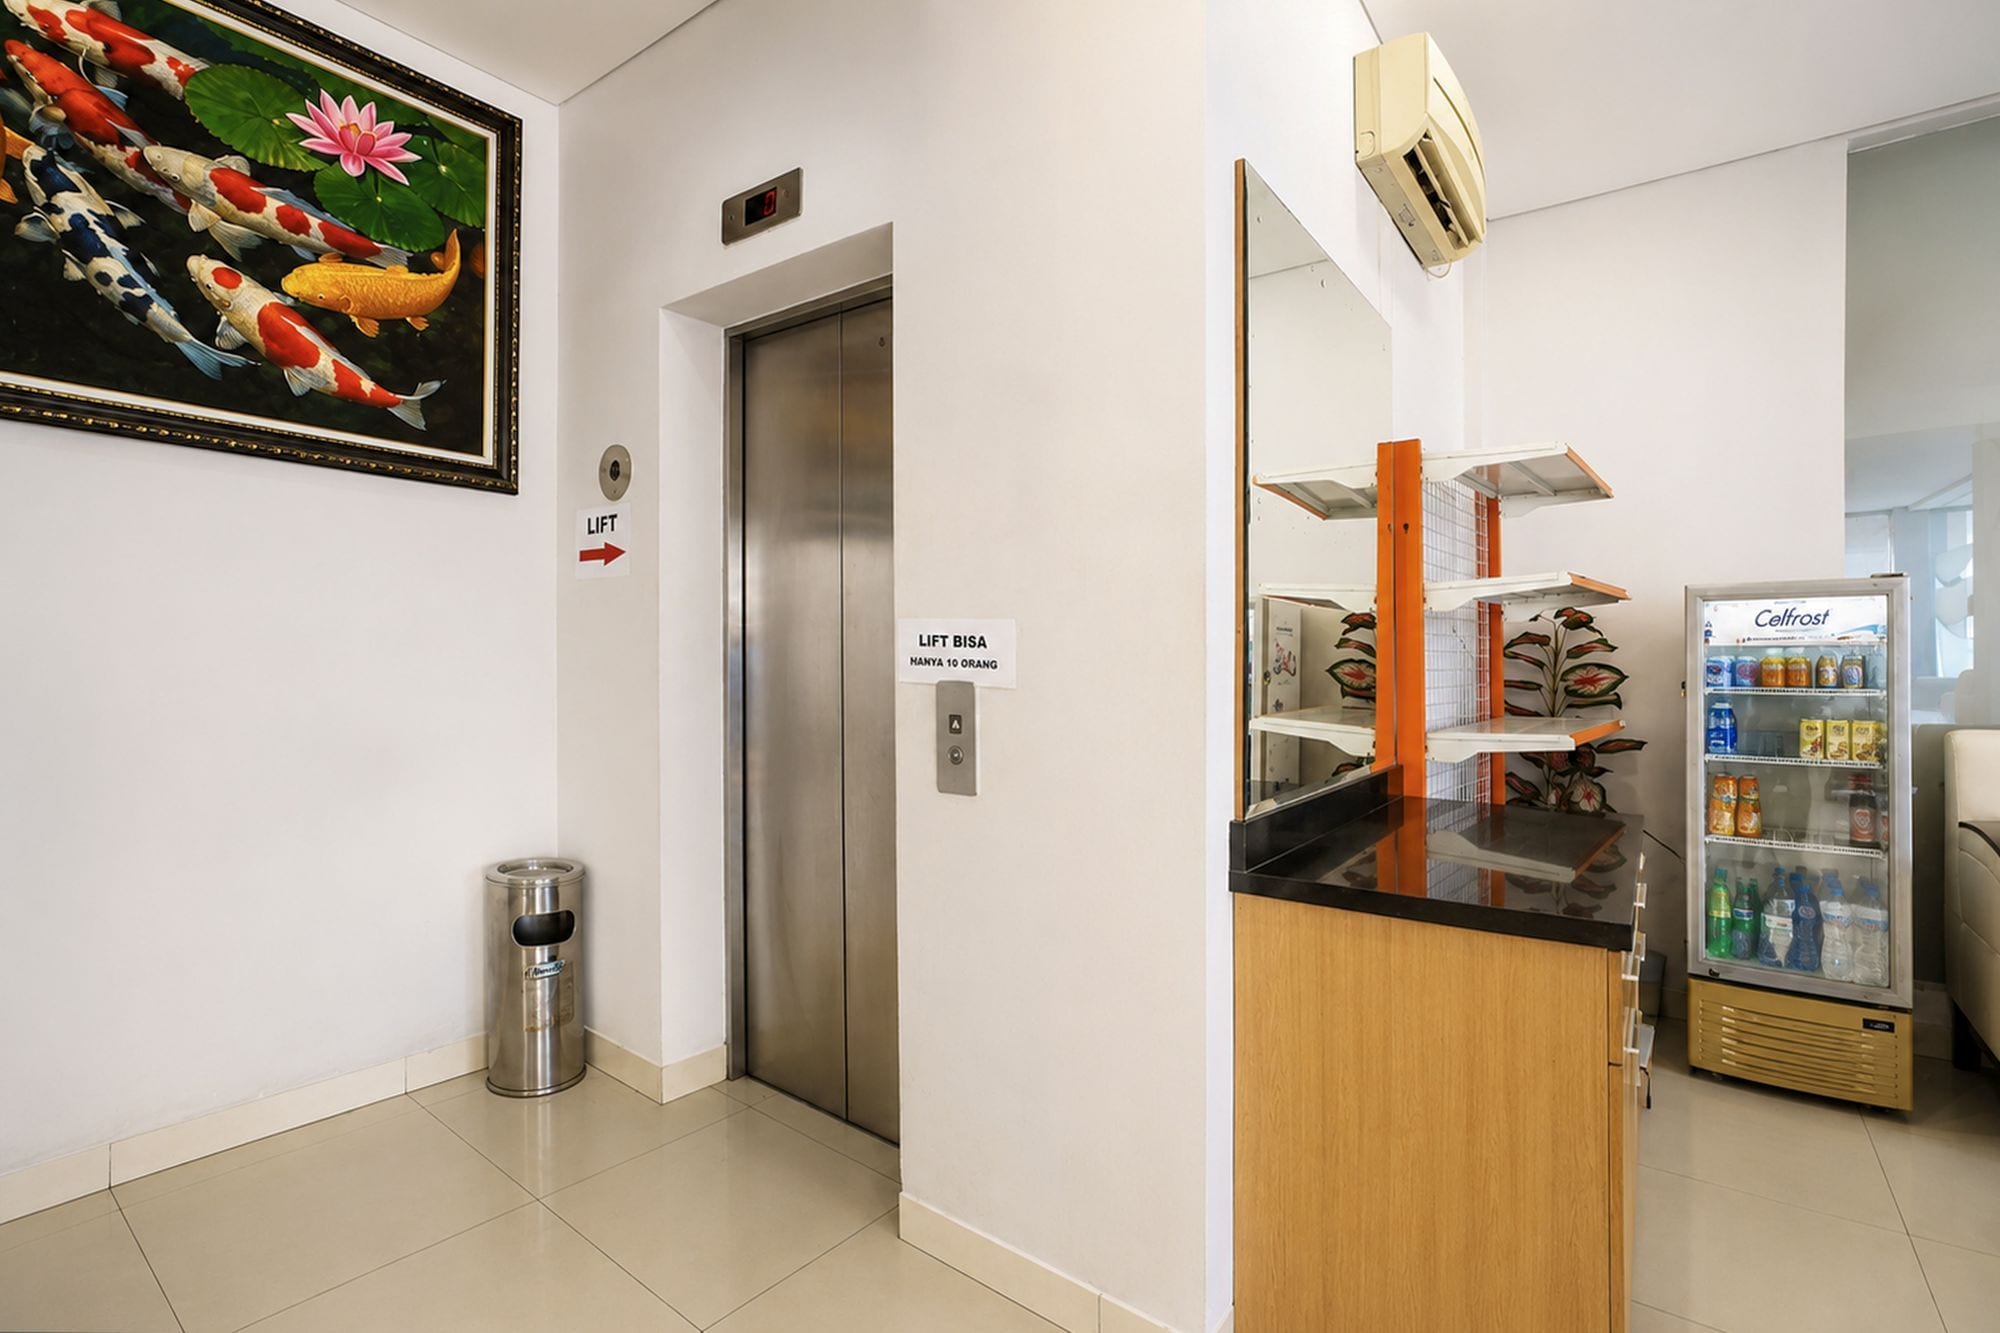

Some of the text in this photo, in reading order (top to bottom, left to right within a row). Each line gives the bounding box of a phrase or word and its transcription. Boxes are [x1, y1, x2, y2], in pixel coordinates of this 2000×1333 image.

[587, 513, 618, 535] LIFT
[1754, 607, 1830, 628] Celfrost
[918, 634, 987, 649] LIFT BISA
[910, 656, 998, 670] HANYA 10 ORANG
